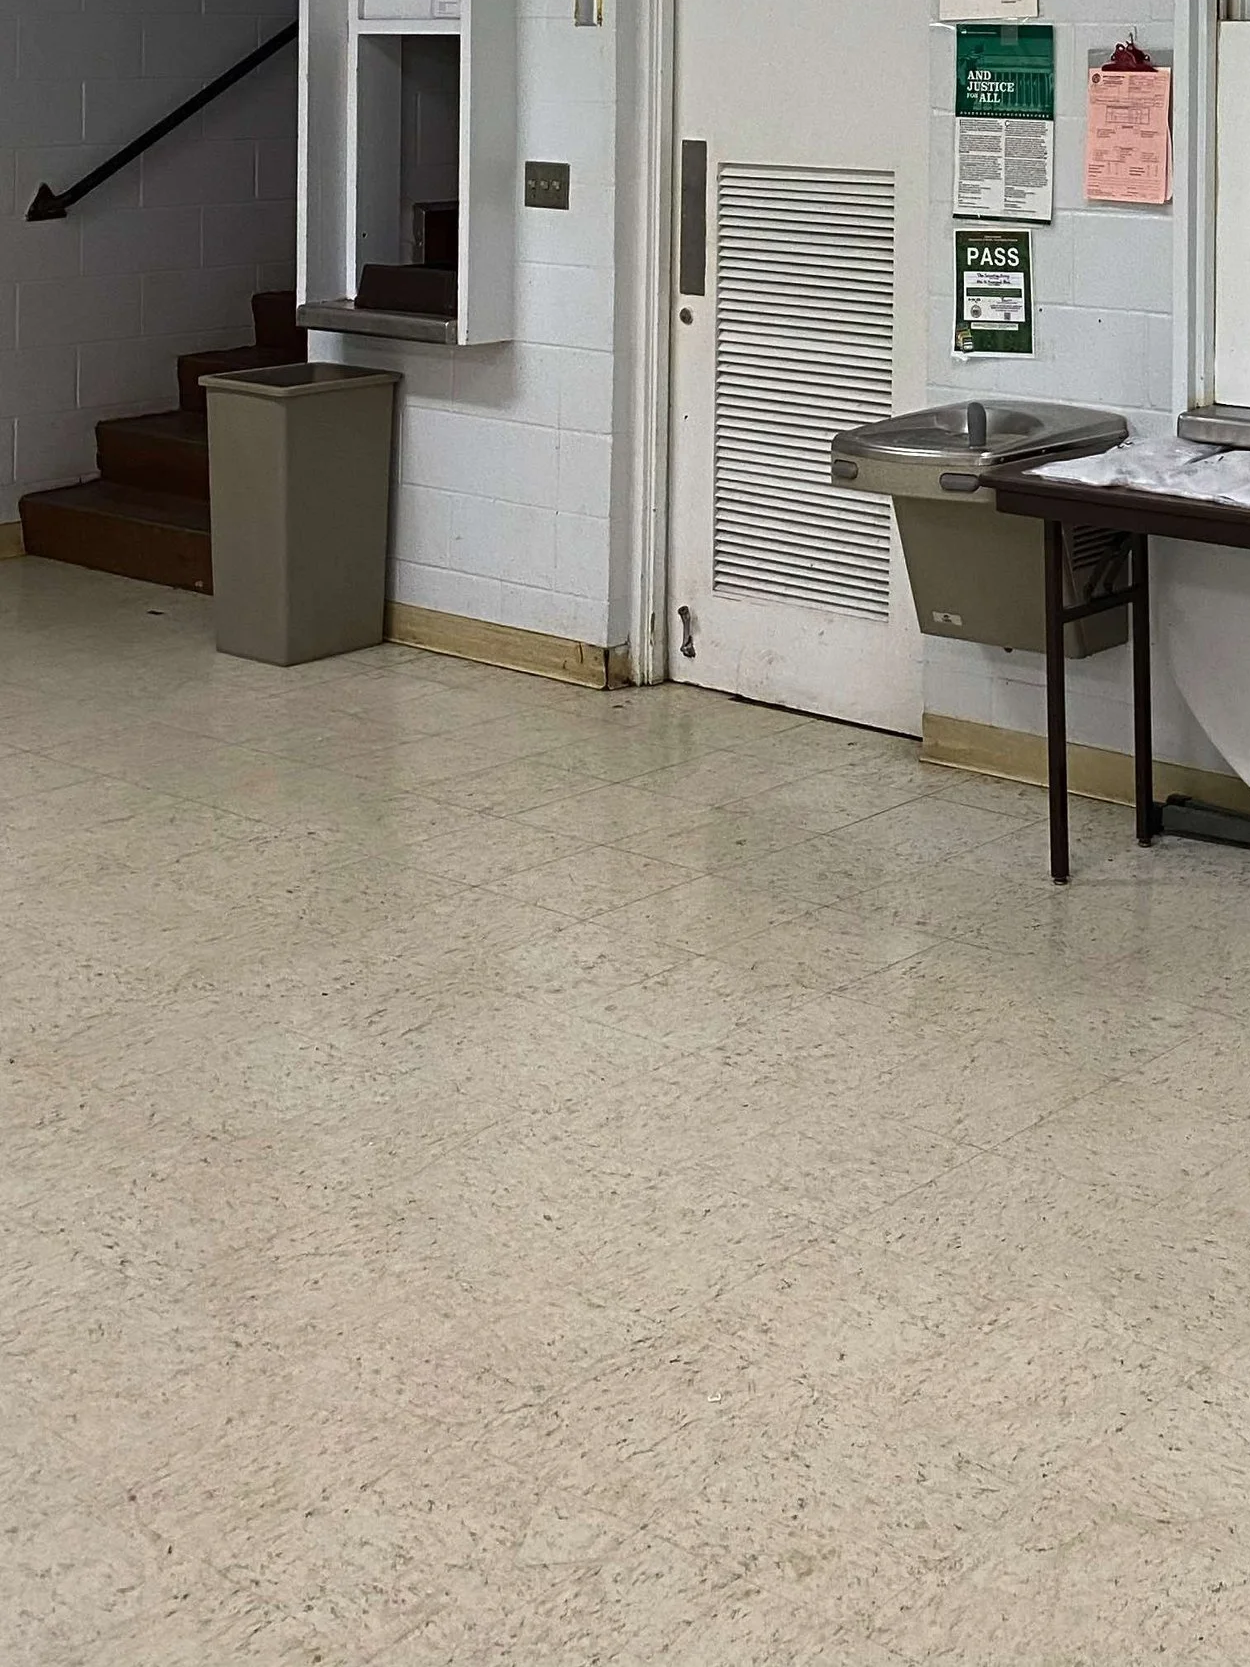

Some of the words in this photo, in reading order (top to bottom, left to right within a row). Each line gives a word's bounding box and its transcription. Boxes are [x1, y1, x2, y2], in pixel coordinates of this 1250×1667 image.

[967, 70, 992, 81] AND
[966, 81, 1015, 92] JUSTICE
[979, 92, 1001, 103] ALL
[966, 247, 1020, 267] PASS
